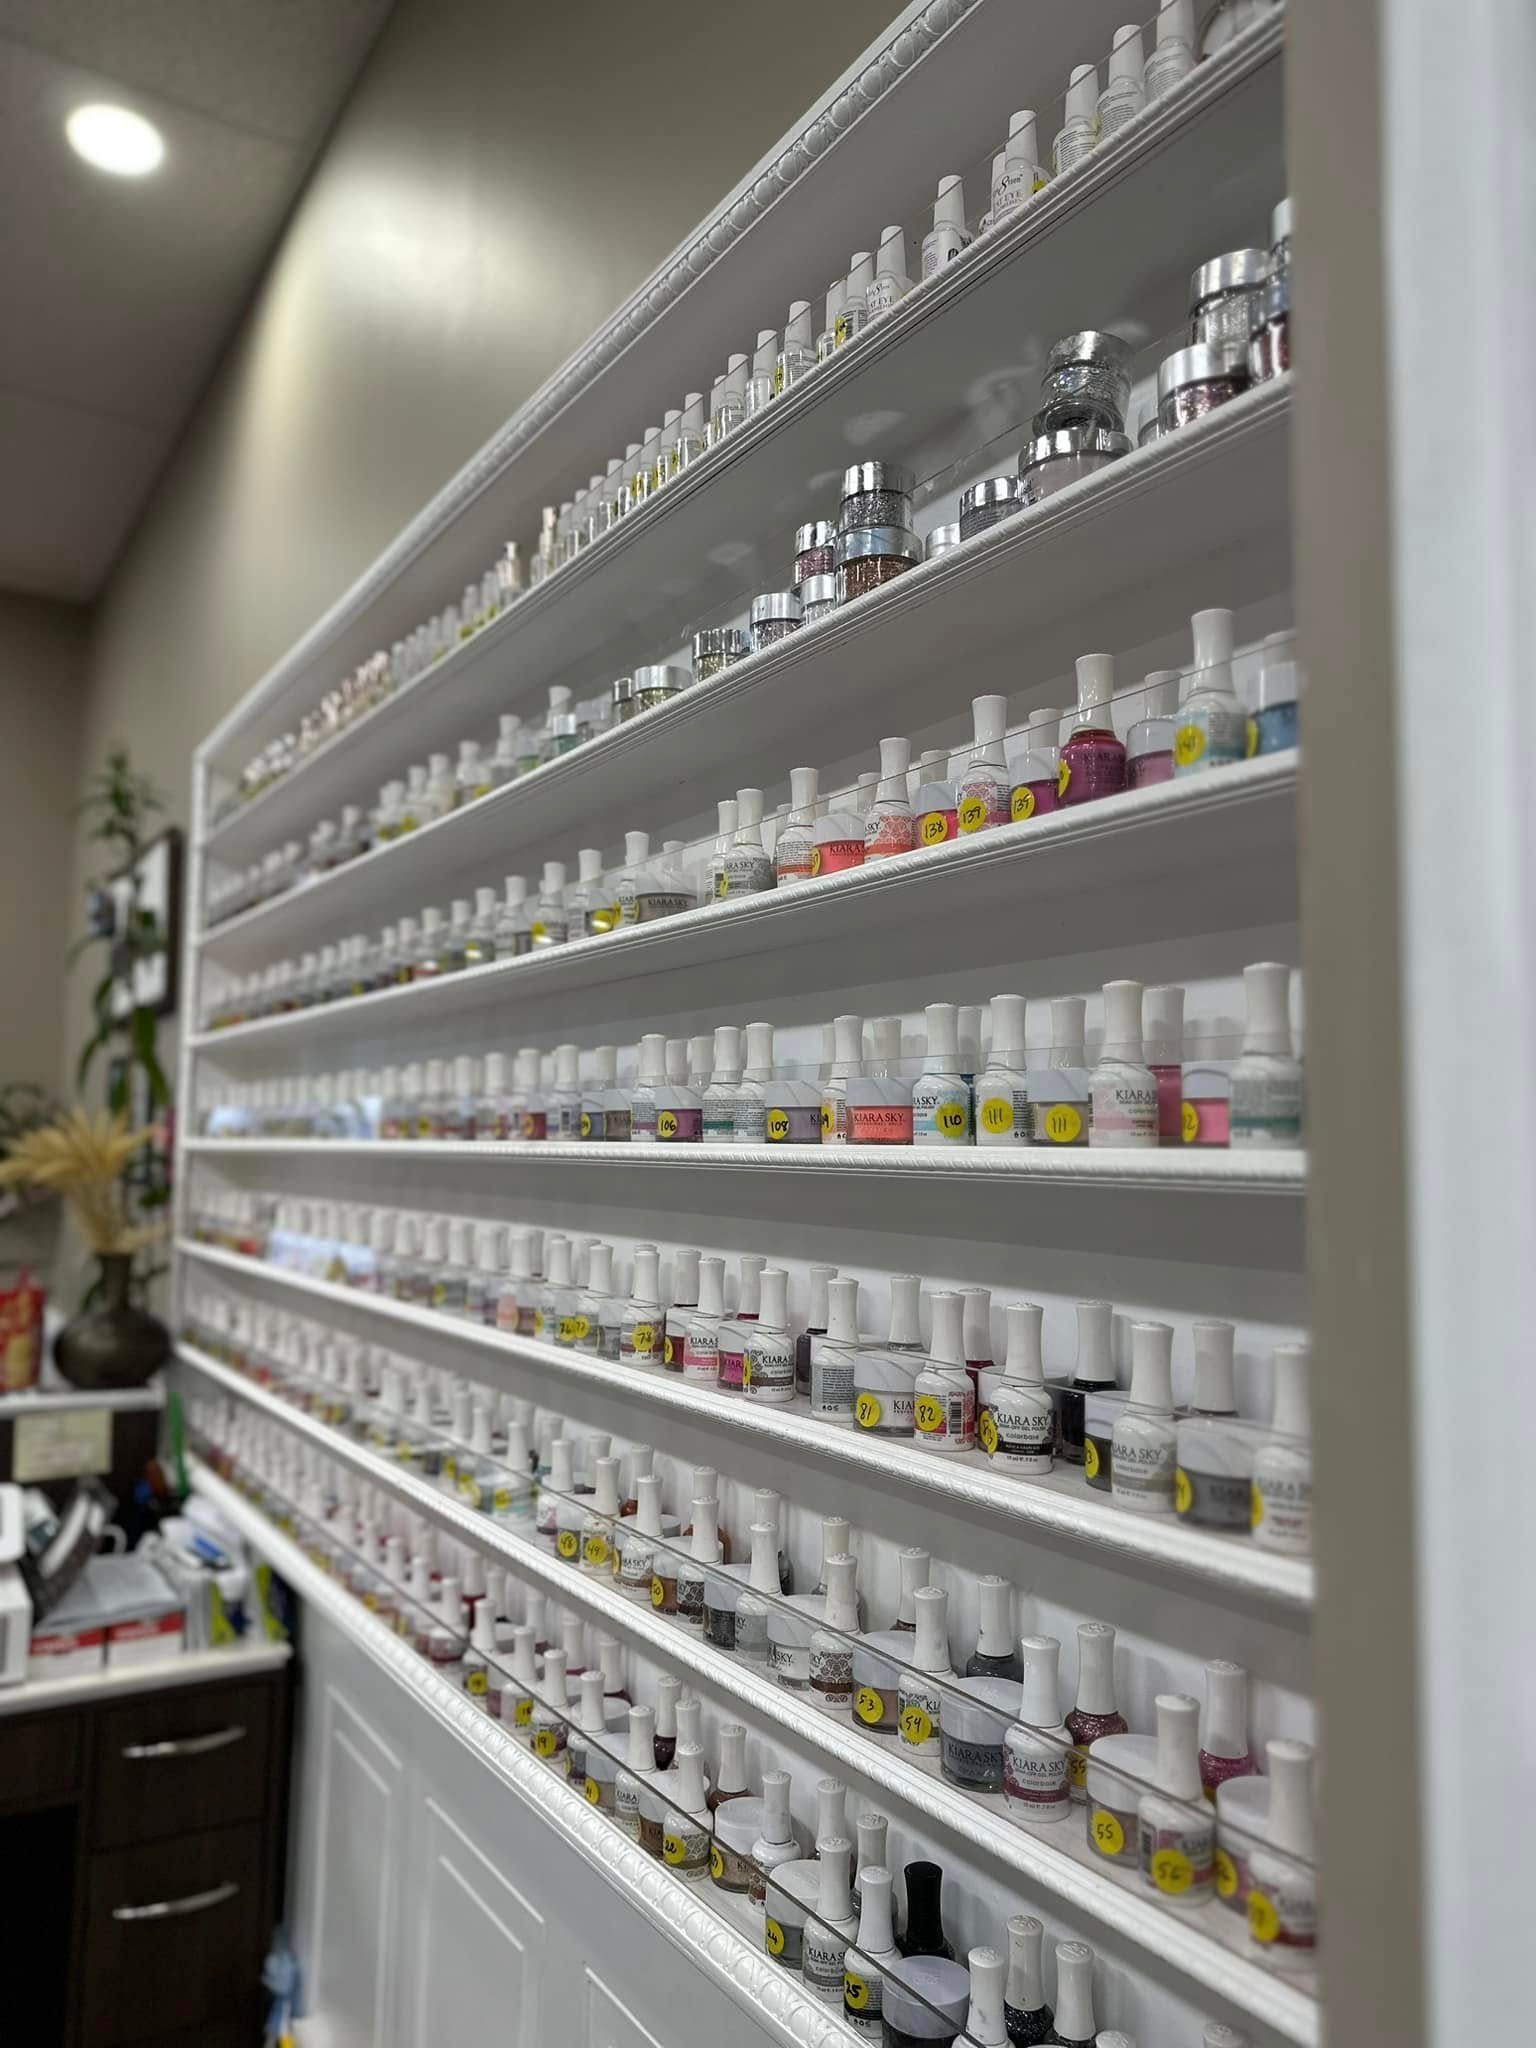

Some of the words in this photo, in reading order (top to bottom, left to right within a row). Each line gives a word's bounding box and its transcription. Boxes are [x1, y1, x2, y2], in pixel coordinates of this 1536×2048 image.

[925, 821, 944, 839] 138
[660, 1119, 677, 1133] 106
[770, 1120, 789, 1134] 108
[919, 1404, 935, 1424] 82
[997, 1412, 1031, 1426] KIARA
[1032, 1415, 1049, 1427] SKY
[858, 1694, 875, 1712] 53
[905, 1715, 922, 1734] 54
[1012, 1756, 1047, 1773] KIARA
